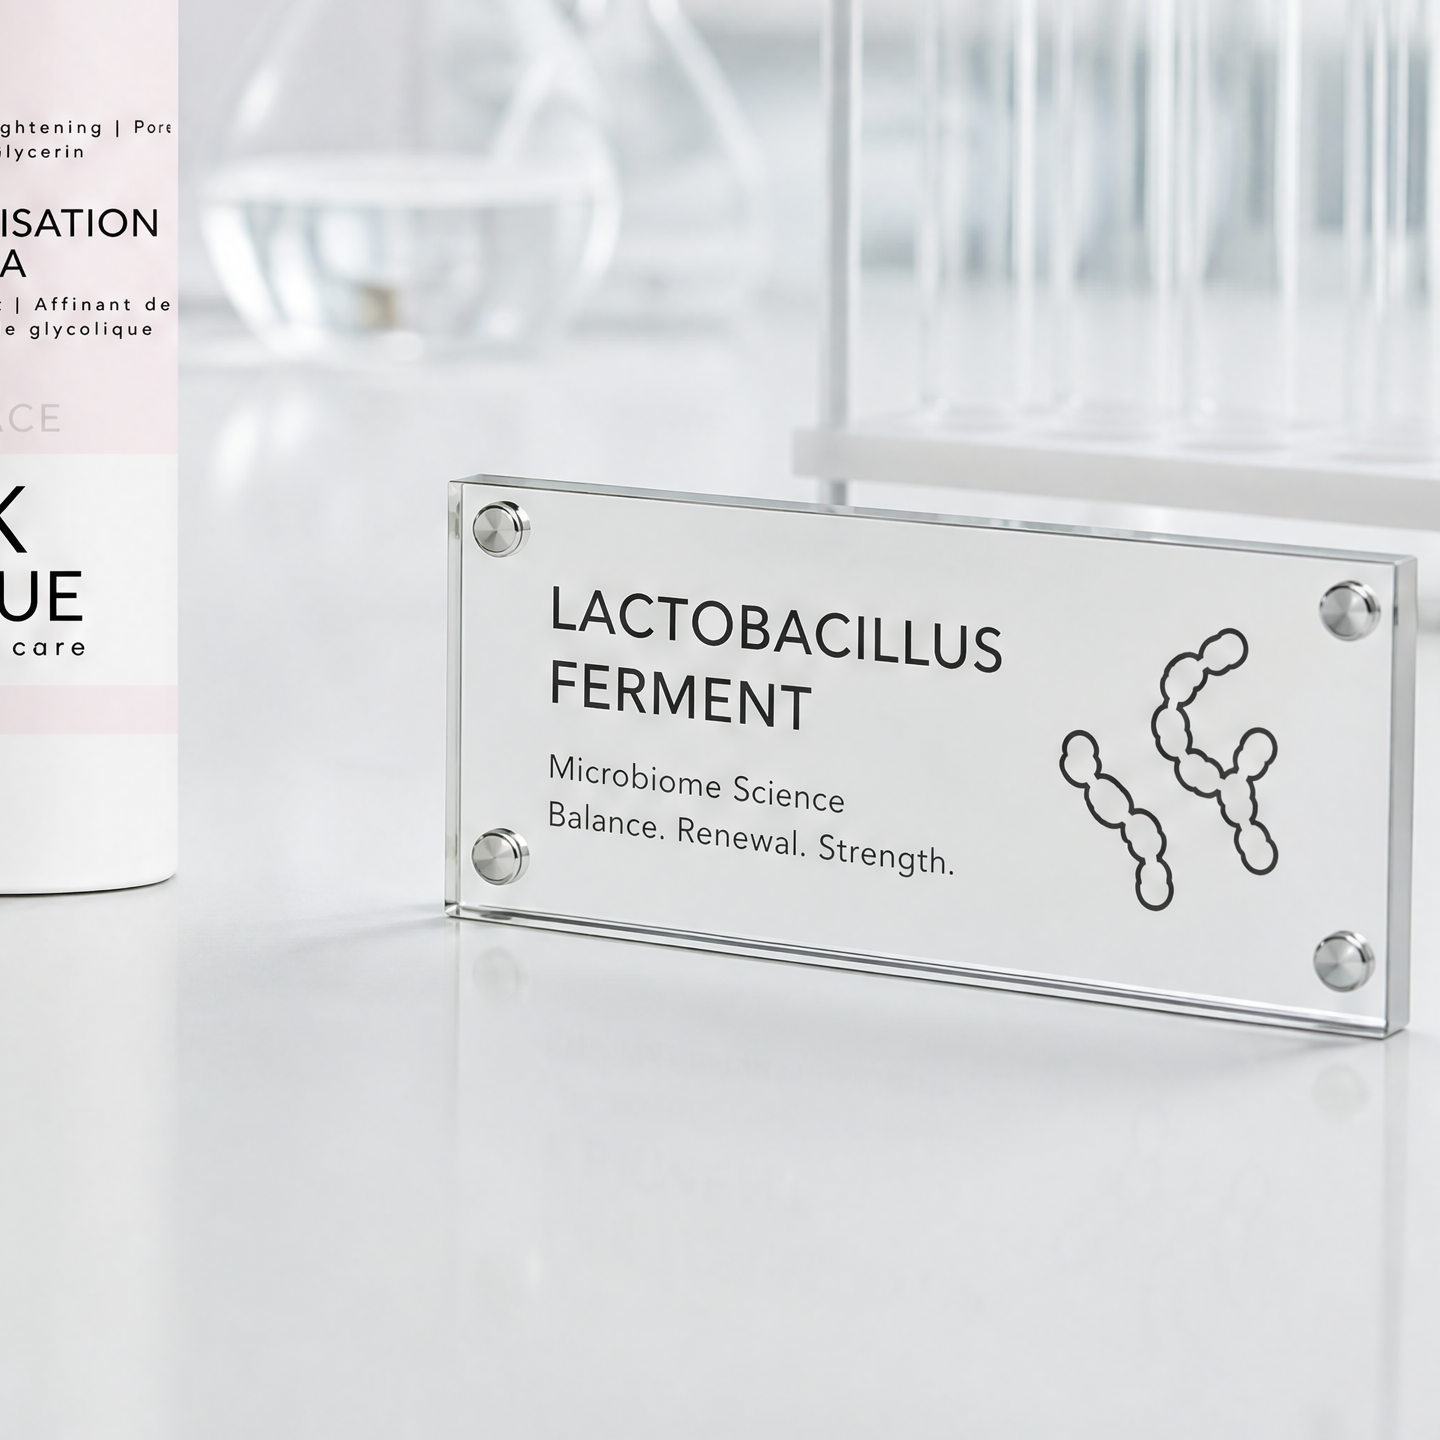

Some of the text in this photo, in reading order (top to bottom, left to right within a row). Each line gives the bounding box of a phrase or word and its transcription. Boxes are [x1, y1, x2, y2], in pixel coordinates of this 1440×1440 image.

[29, 321, 153, 340] glycolique
[34, 296, 131, 312] Affinant
[145, 296, 171, 312] de
[12, 641, 86, 657] care
[552, 586, 1003, 673] LACTOBACILLUS
[551, 660, 812, 730] FERMENT
[548, 753, 845, 813] Microbiome Science
[548, 800, 955, 878] Balance. Renewal. Strength.
